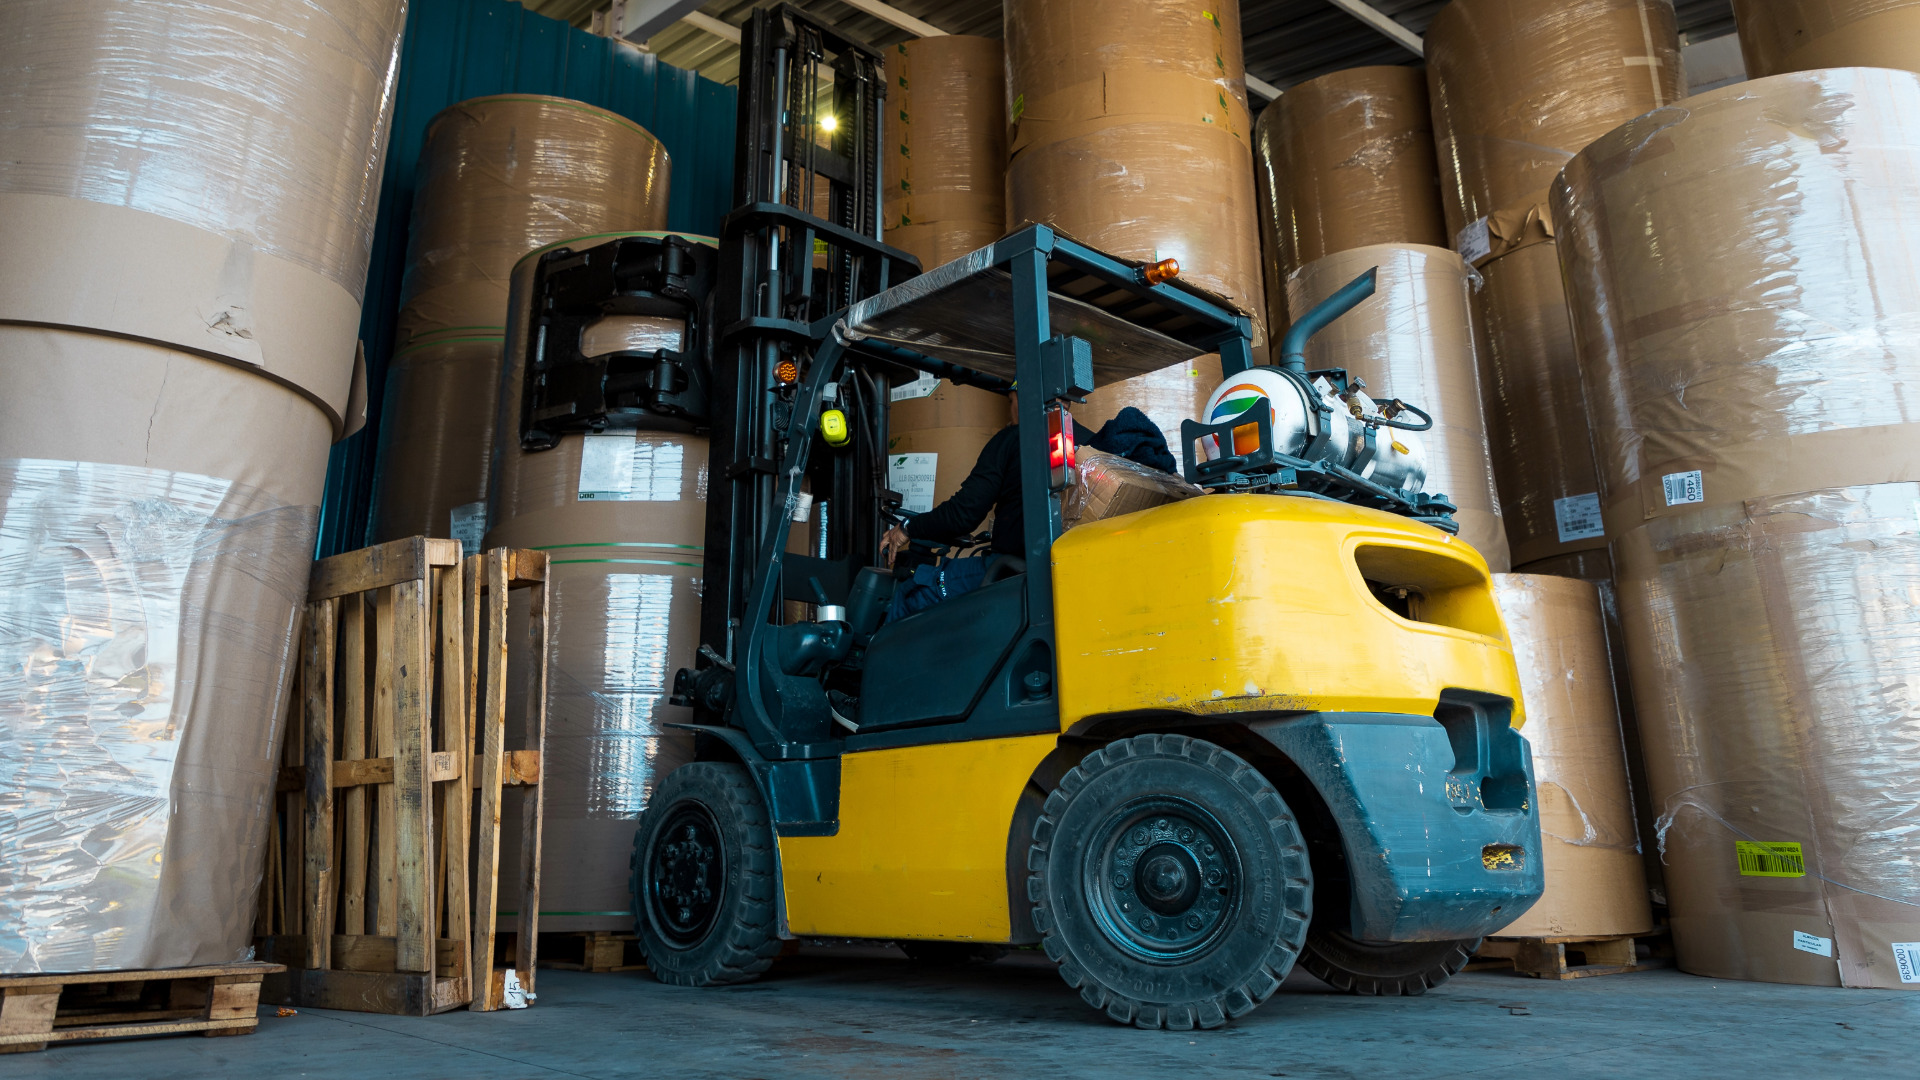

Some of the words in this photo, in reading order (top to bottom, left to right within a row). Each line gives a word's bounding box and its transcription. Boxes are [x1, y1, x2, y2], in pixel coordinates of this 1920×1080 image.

[1687, 472, 1696, 502] 1460
[1895, 948, 1912, 981] 000639
[508, 981, 521, 1000] 15
